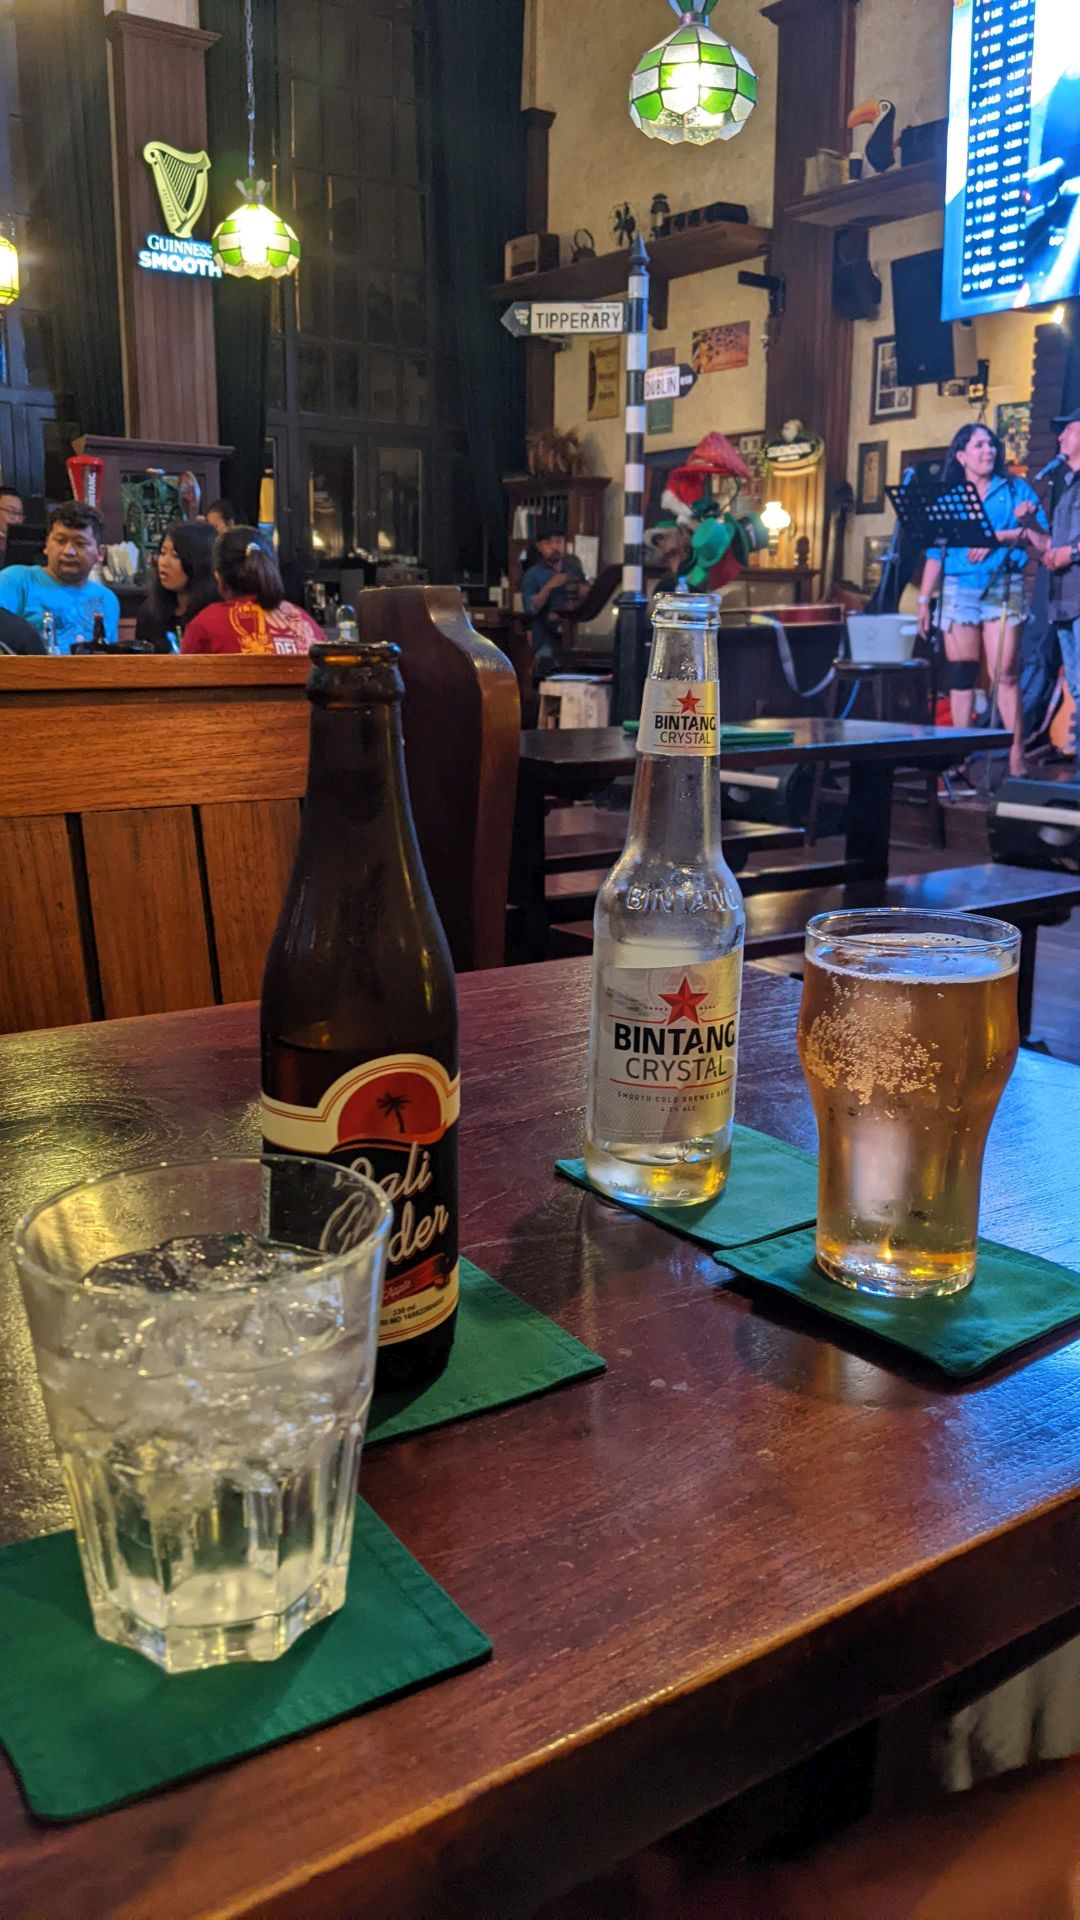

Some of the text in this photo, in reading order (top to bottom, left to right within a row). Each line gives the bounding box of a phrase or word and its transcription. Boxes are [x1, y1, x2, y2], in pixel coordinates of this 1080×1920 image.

[147, 234, 213, 258] GUINNESS
[138, 250, 222, 278] SMOOTH
[535, 311, 621, 329] TIPPERARY
[655, 715, 716, 731] BINTANG
[660, 731, 711, 745] CRYSTAL
[614, 1020, 735, 1056] BINTANG
[626, 1055, 727, 1082] CRYSTAL
[617, 1086, 730, 1104] SMOOTH COLD BREWED BEER
